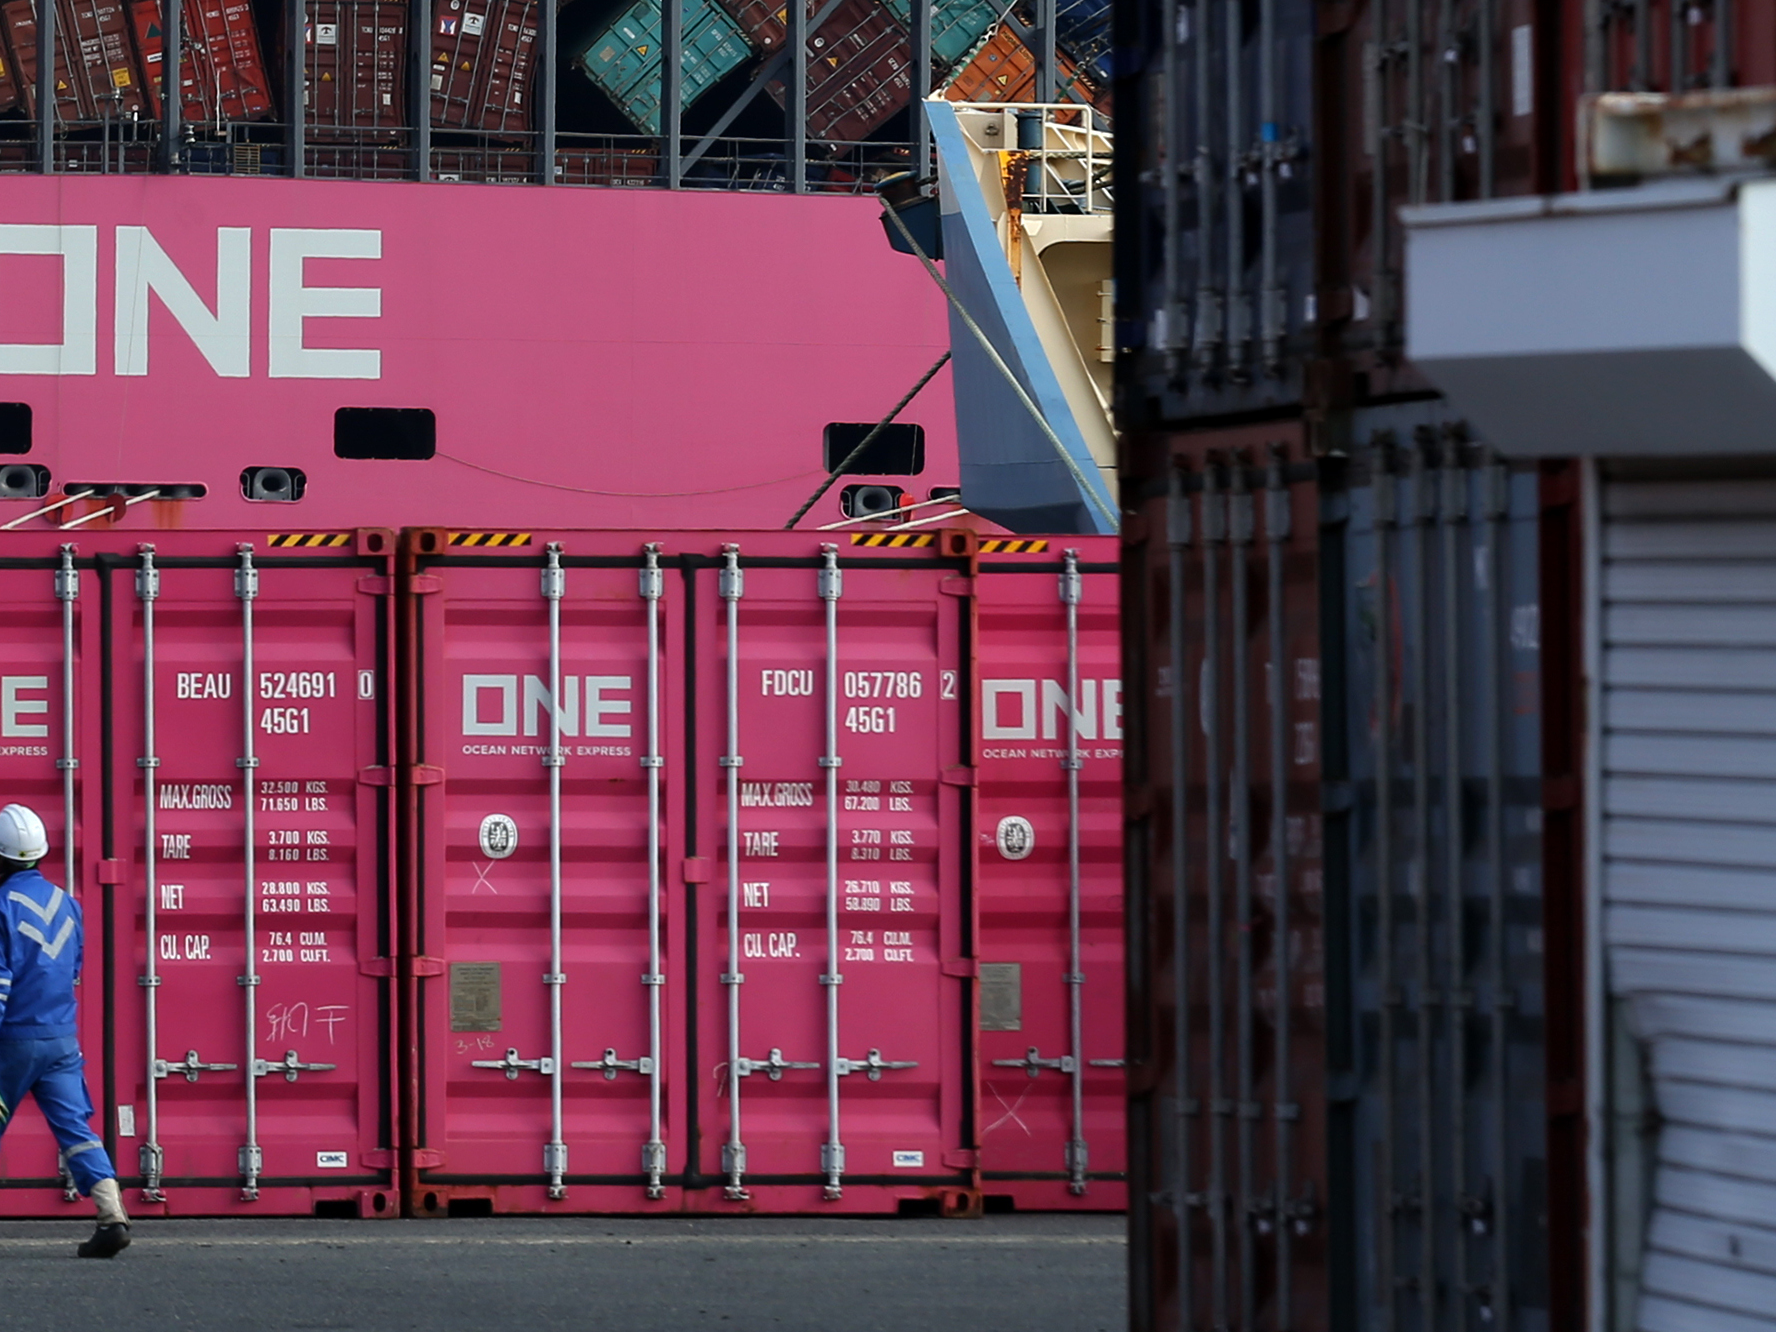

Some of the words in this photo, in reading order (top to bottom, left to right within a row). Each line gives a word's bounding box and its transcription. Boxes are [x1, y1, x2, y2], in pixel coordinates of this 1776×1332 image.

[177, 673, 231, 699] BEAU
[260, 672, 336, 698] 524691
[359, 671, 373, 698] 0
[761, 670, 813, 696] FDCU
[845, 672, 922, 698] 057786
[942, 671, 956, 699] 2
[462, 674, 631, 737] ONE
[261, 708, 309, 733] 45G1
[845, 707, 895, 732] 45G1
[462, 745, 506, 755] OCEAN
[577, 746, 631, 756] EXPRESS
[983, 749, 1026, 758] OCEAN
[160, 785, 232, 809] MAX.GROSS
[261, 781, 298, 794] 32.500
[306, 781, 328, 794] KGS.
[261, 798, 298, 811] 71.650
[306, 798, 328, 811] LBS.
[741, 783, 813, 807] MAX.GROSS
[889, 797, 912, 811] LBS.
[161, 835, 191, 859] TARE
[269, 831, 299, 844] 3.700
[307, 831, 330, 844] KGS.
[307, 849, 329, 861] LBS.
[744, 832, 778, 856] TARE
[890, 830, 914, 844] KGS.
[890, 849, 912, 861] LBS.
[161, 885, 184, 909] NET
[262, 882, 300, 895] 28.800
[307, 882, 330, 895] KGS.
[262, 899, 300, 912] 63.490
[308, 899, 330, 912] LBS.
[744, 882, 770, 907] NET
[890, 881, 914, 894] KGS.
[891, 898, 914, 911] LBS.
[160, 935, 180, 959] CU.
[186, 935, 210, 959] CAP.
[270, 932, 292, 945] 76.4
[263, 949, 293, 962] 2.700
[744, 933, 765, 958] CU.
[769, 933, 800, 958] CAP.
[851, 931, 873, 944] 76.4
